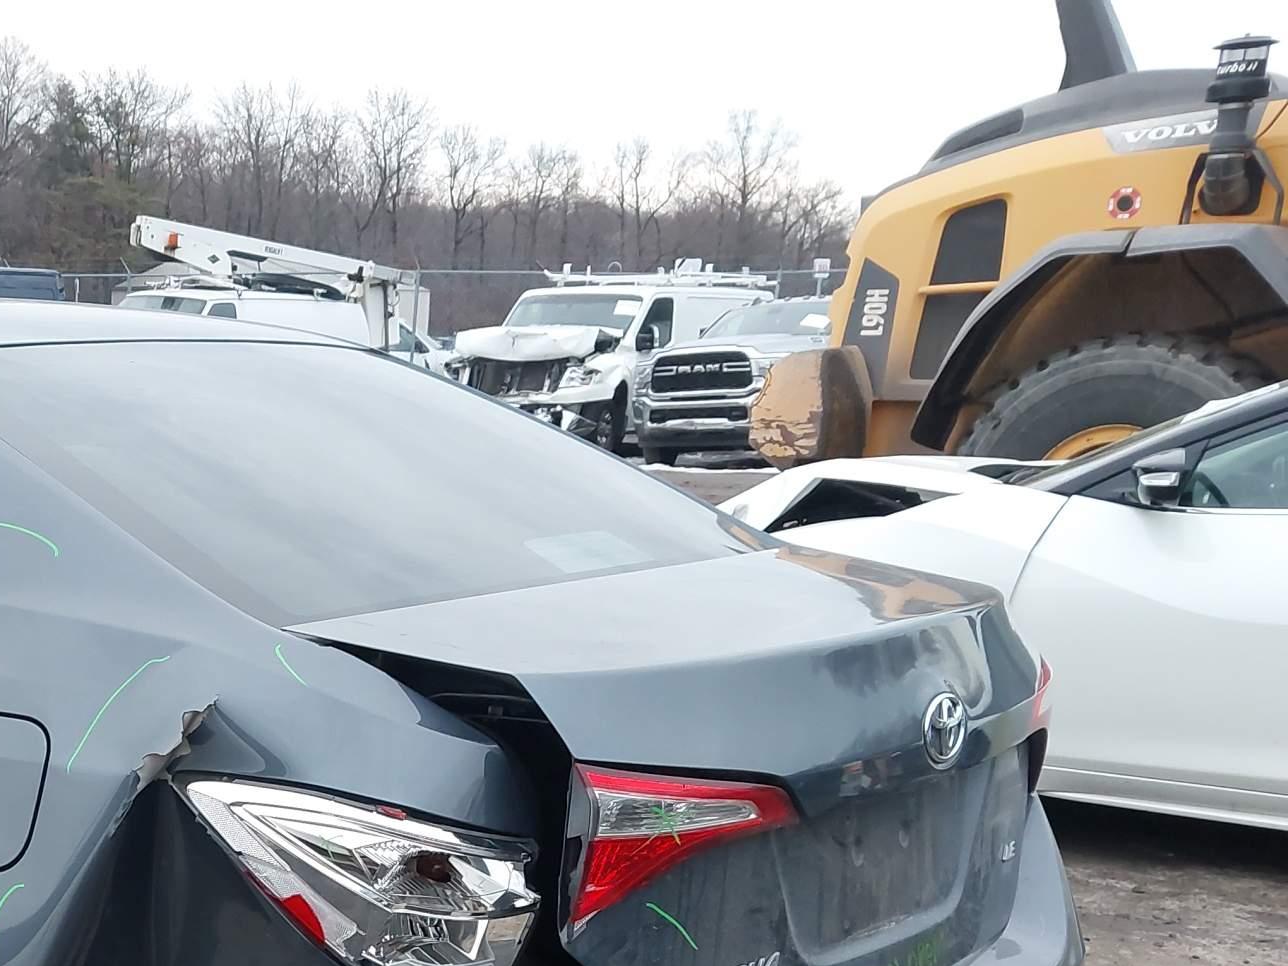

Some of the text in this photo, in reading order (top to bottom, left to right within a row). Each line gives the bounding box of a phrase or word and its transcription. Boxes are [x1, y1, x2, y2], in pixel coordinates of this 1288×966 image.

[1216, 62, 1247, 76] turbo
[1120, 119, 1219, 144] VOLV
[859, 288, 890, 336] L90H
[677, 363, 721, 375] RAM
[1001, 840, 1016, 860] LE
